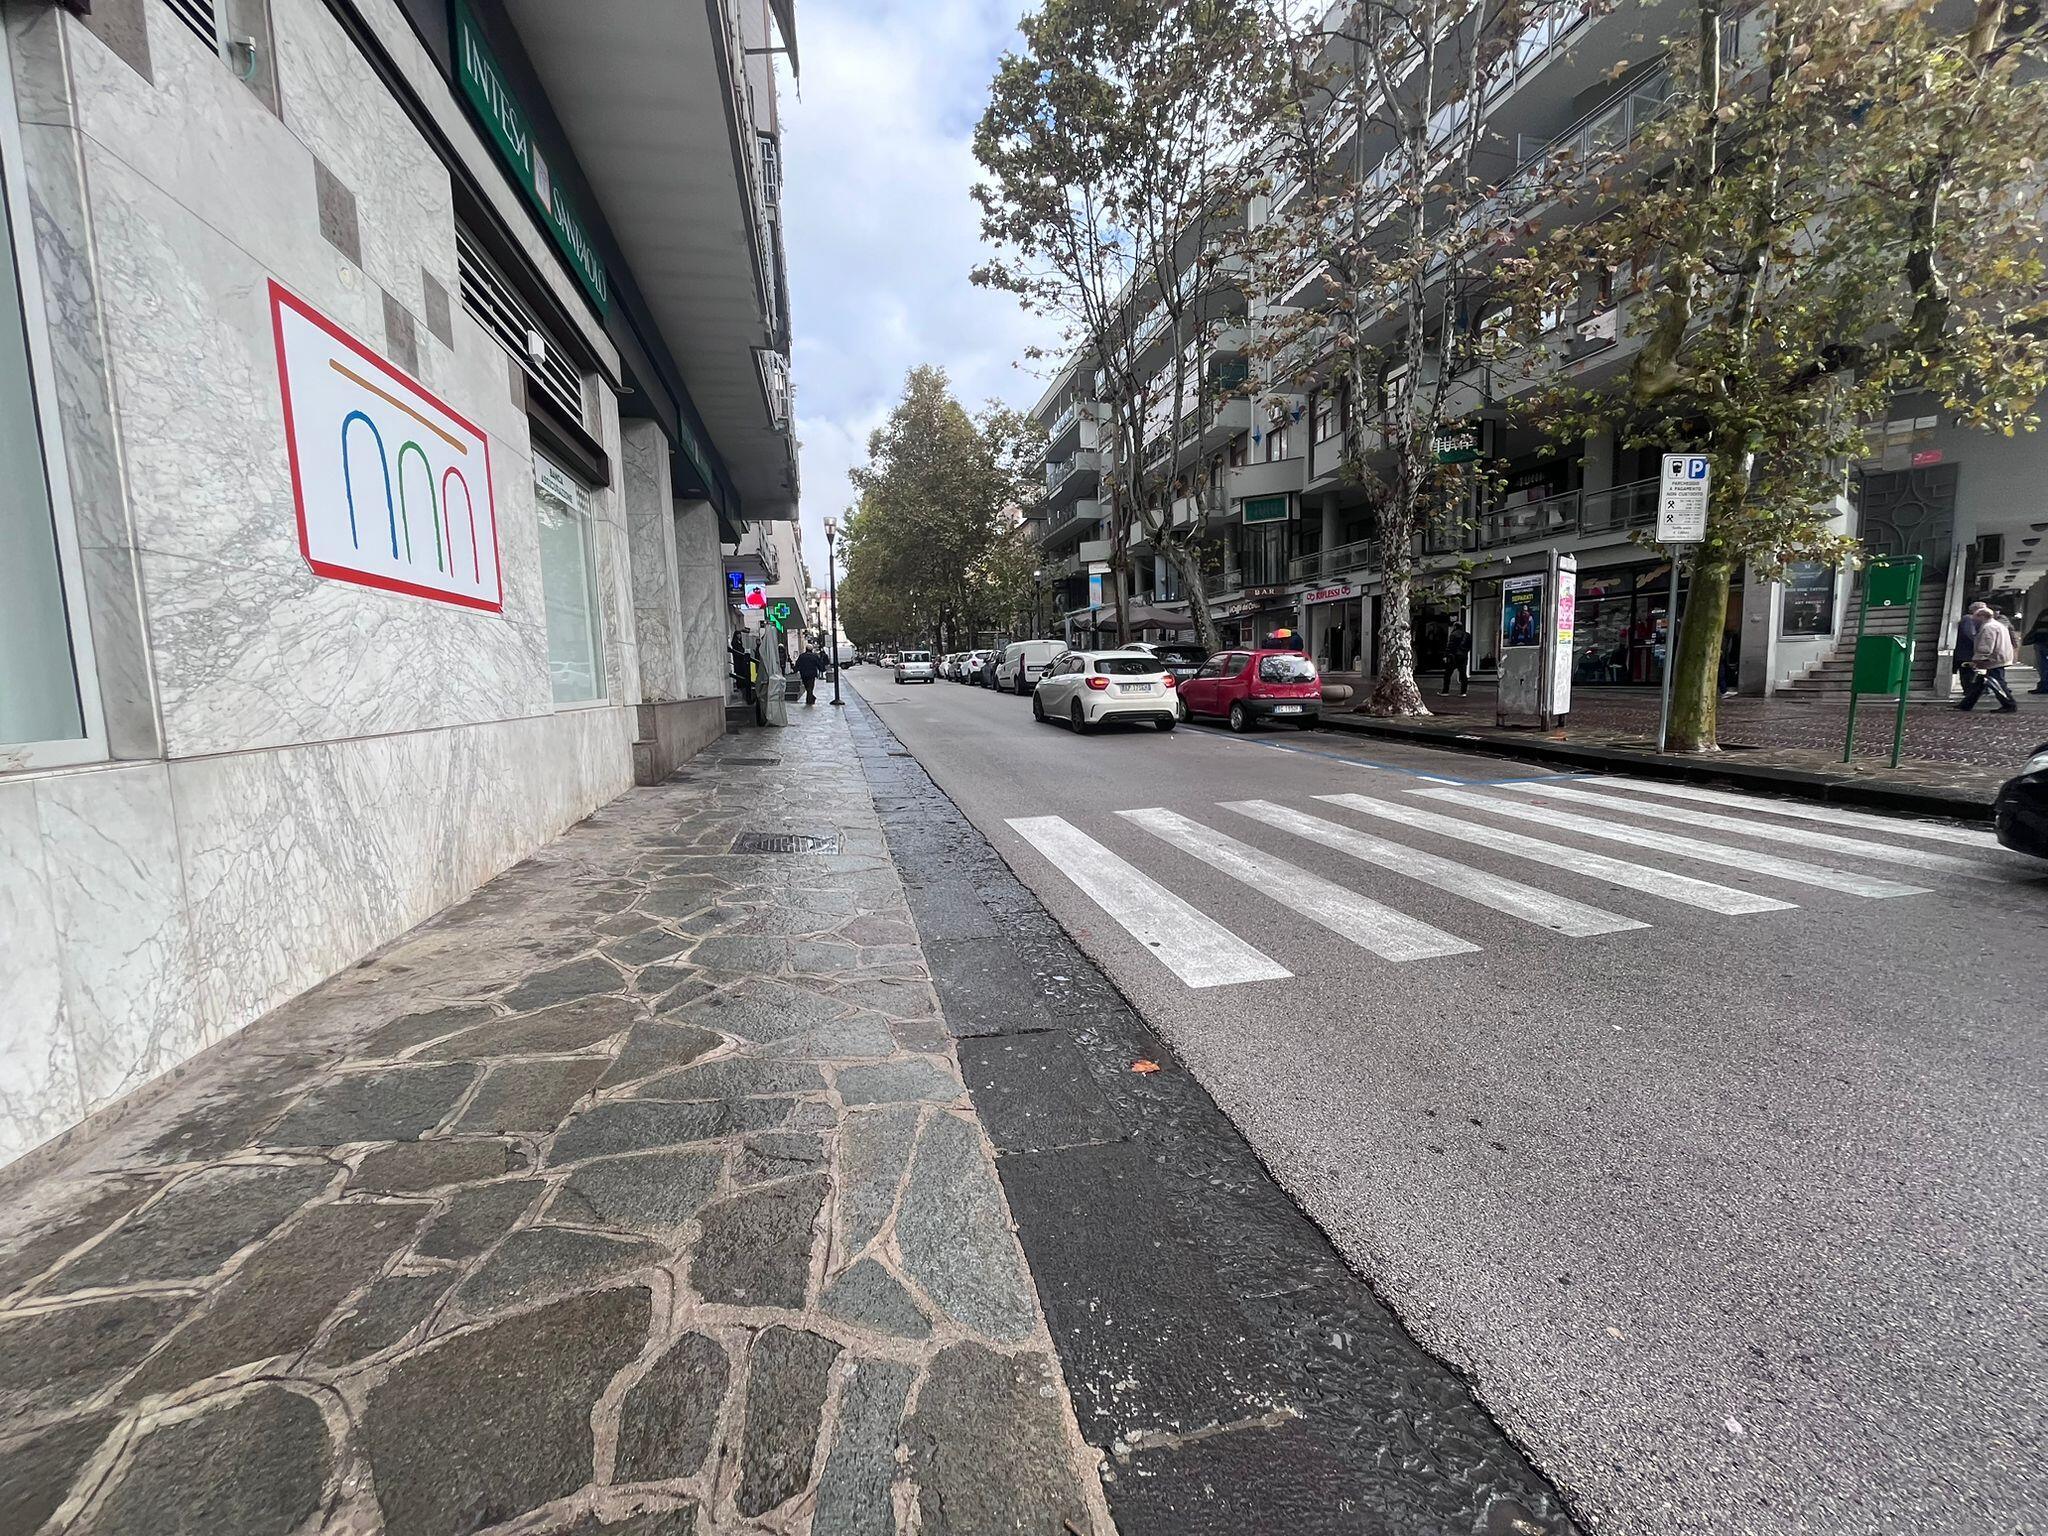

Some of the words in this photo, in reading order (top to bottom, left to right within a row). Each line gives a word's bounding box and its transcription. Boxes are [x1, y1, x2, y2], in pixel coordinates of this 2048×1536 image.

[463, 22, 531, 174] INTESA
[552, 186, 608, 303] SANPAOLO
[1692, 460, 1703, 477] P
[1254, 588, 1275, 596] BAR
